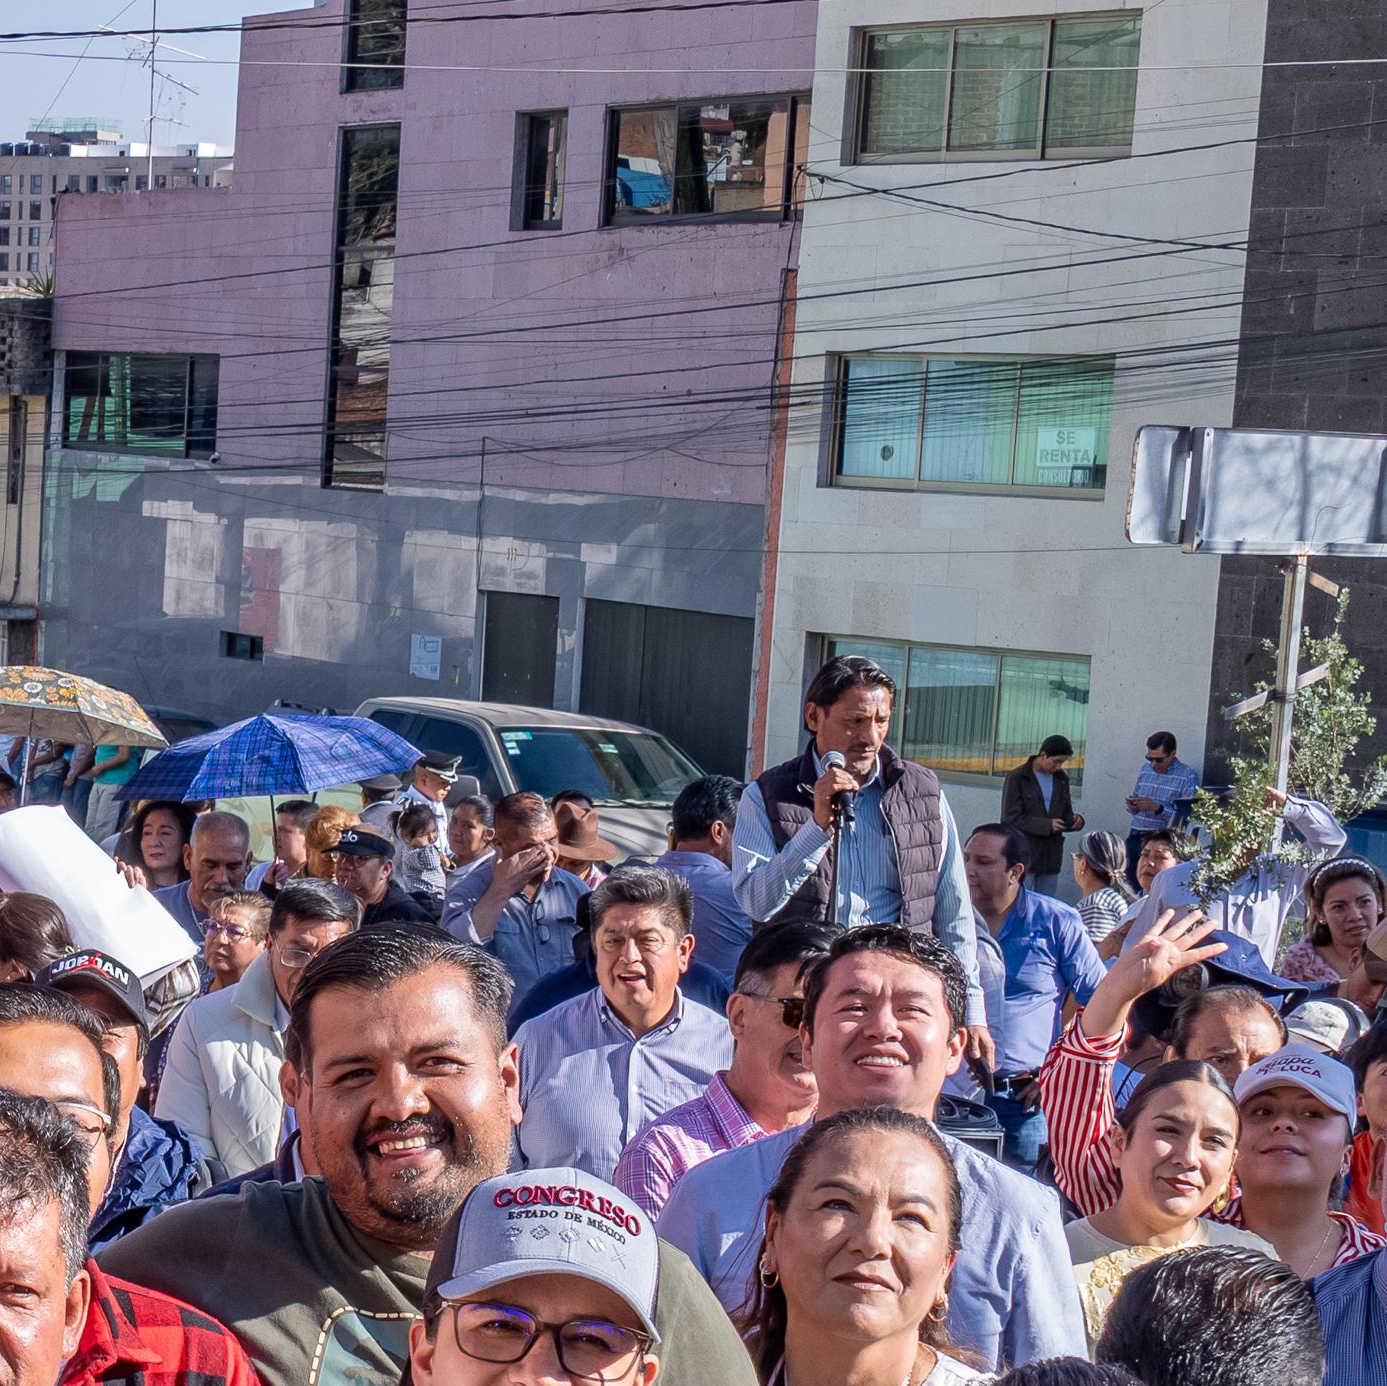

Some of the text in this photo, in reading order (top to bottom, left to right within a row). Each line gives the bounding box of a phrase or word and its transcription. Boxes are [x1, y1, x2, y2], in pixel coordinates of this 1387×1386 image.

[1056, 430, 1076, 445] SE
[1039, 449, 1091, 463] RENTA
[493, 1185, 642, 1237] CONGRESO
[507, 1209, 626, 1246] ESTADO DE MÉXICO
